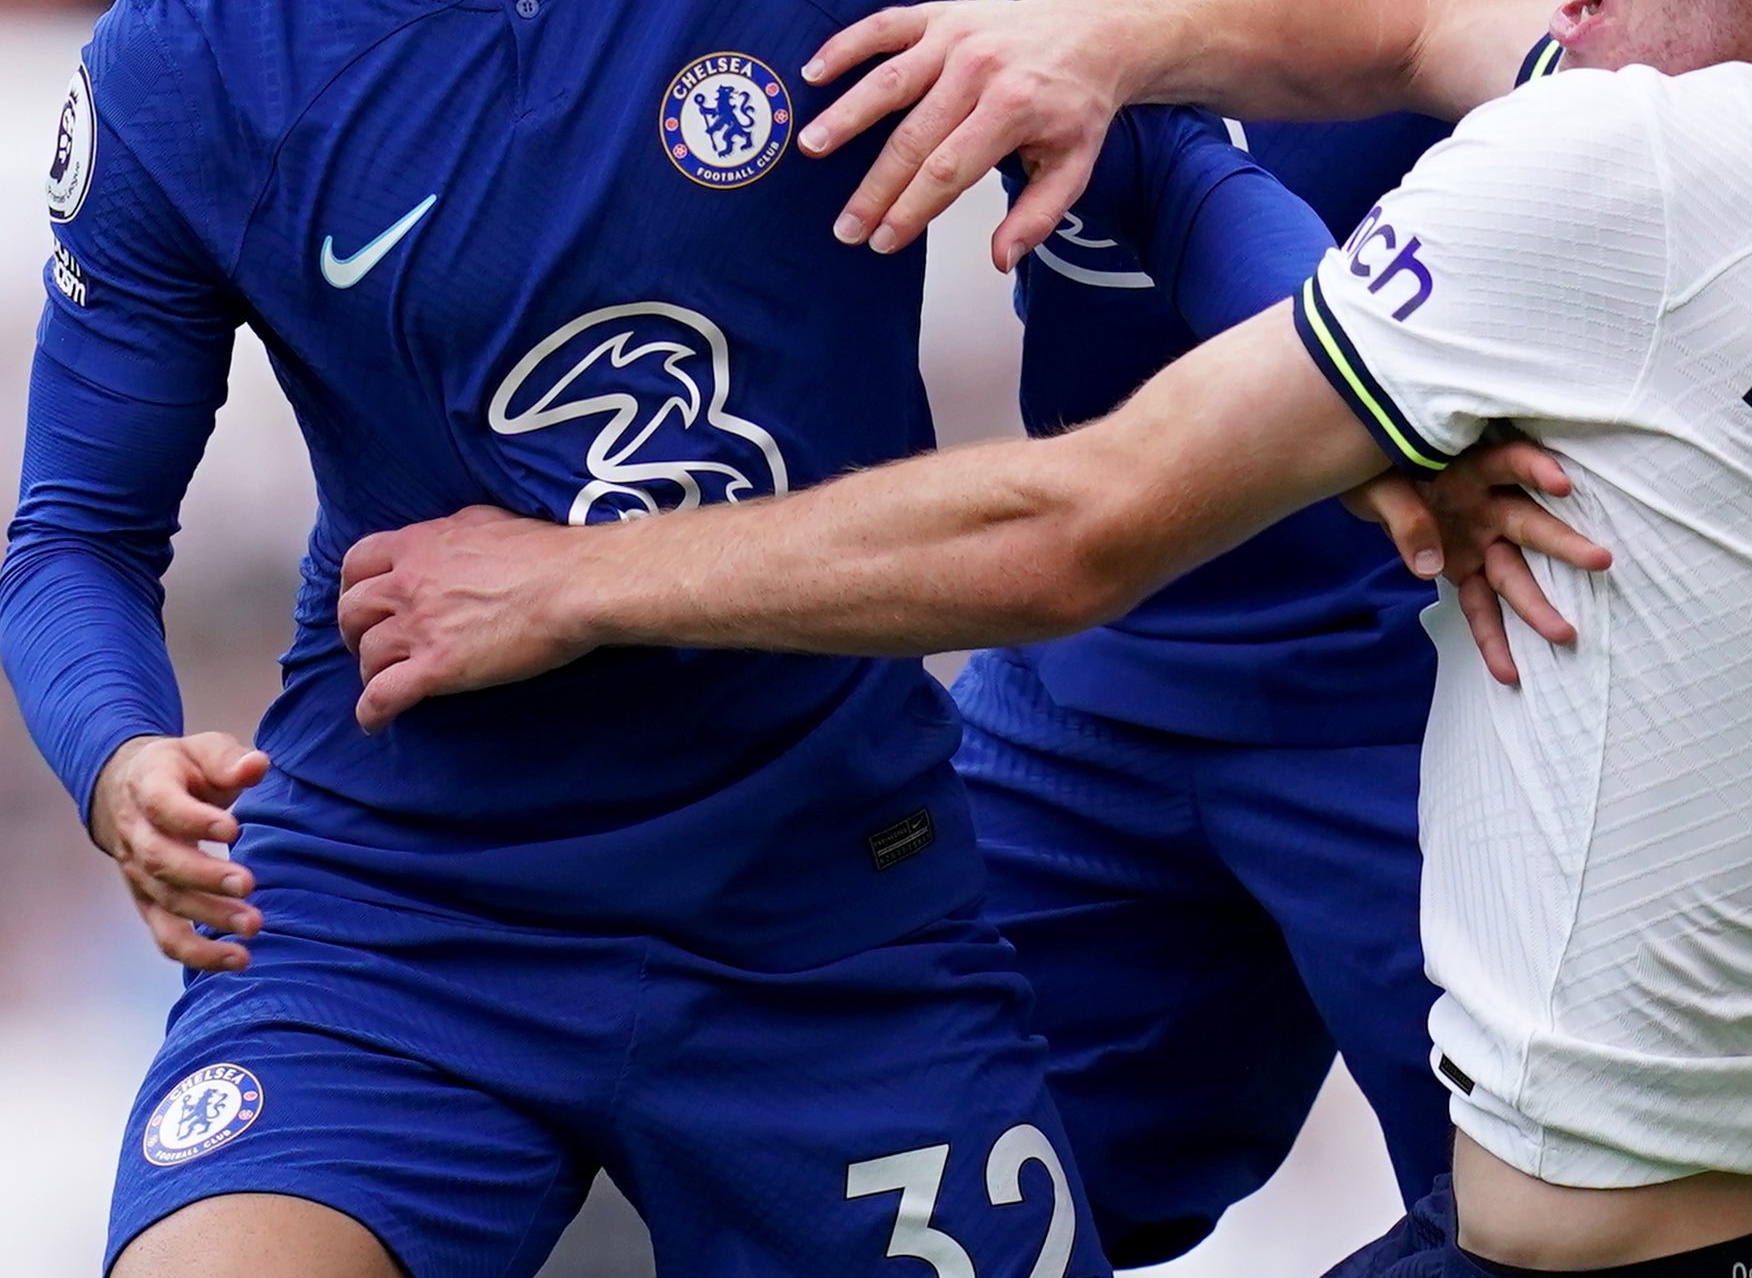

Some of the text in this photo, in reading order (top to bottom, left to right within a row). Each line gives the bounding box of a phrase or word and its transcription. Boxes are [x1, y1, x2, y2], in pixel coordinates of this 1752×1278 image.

[672, 57, 753, 101] CHELSEA
[696, 141, 780, 182] FOOTBALL CLUB
[169, 1067, 246, 1103] CHELSEA
[203, 1129, 232, 1149] CLUB
